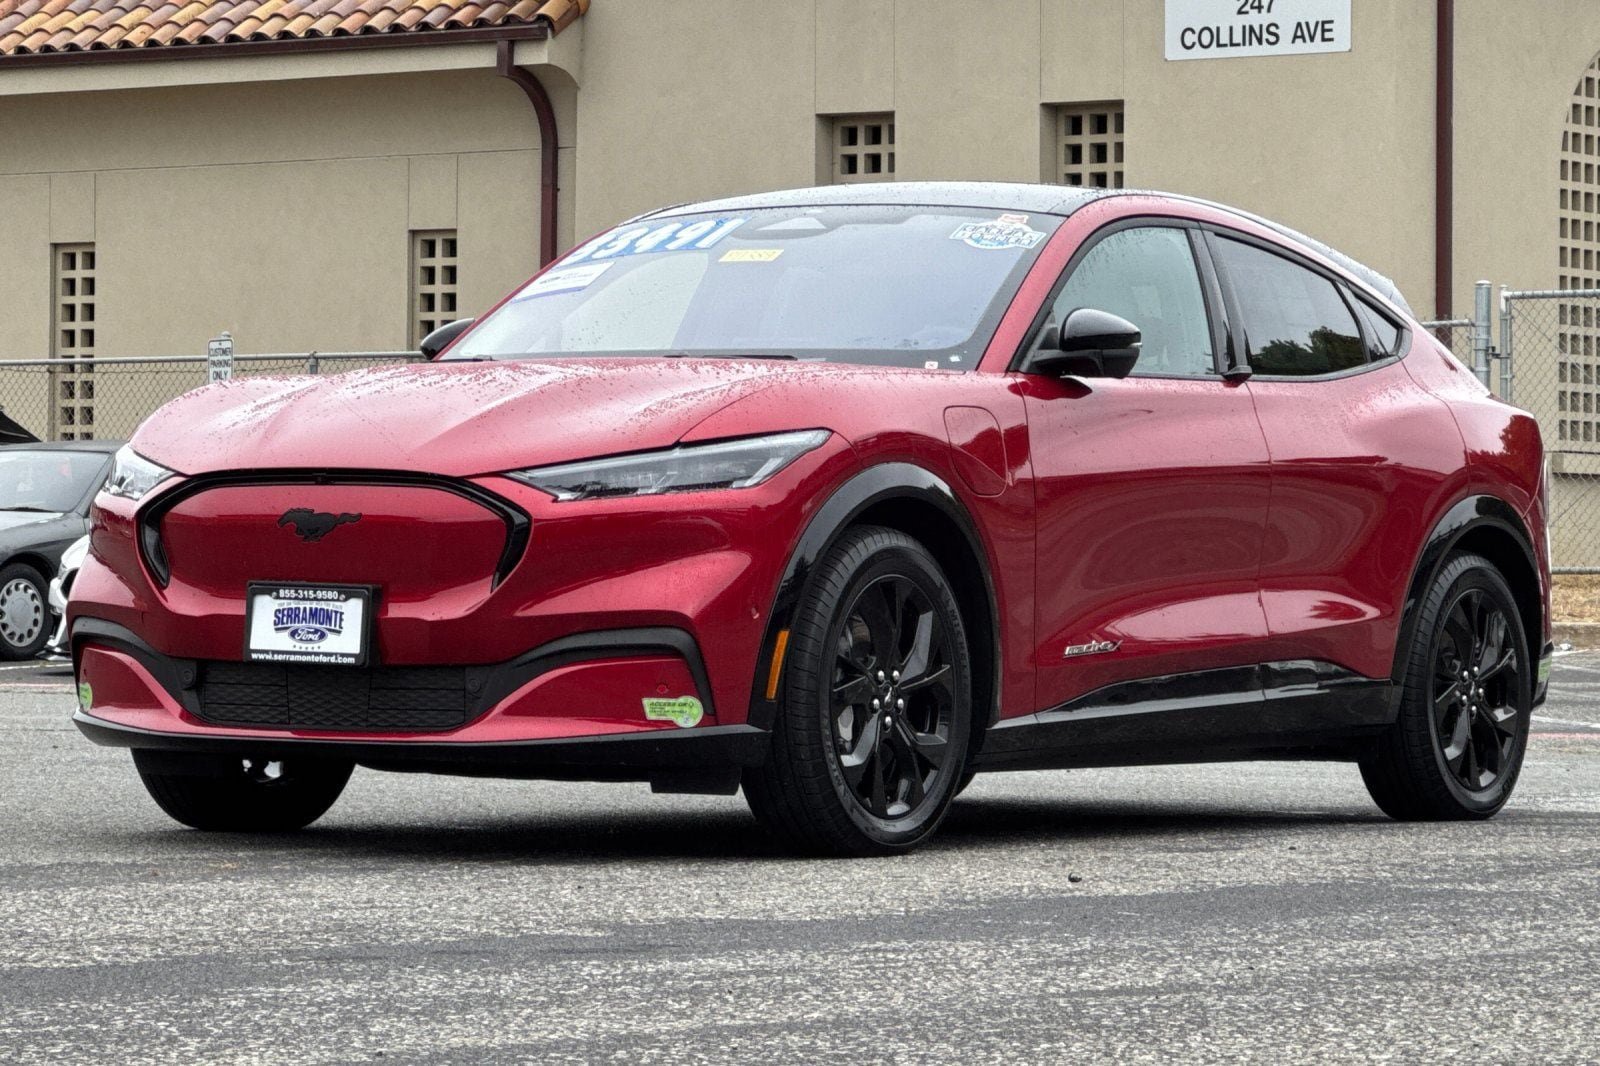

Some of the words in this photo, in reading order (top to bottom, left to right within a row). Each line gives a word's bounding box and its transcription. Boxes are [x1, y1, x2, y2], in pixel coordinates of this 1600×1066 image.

[1236, 0, 1275, 15] 247
[1180, 22, 1280, 51] COLLINS
[1290, 19, 1335, 45] AVE
[210, 359, 231, 368] PARKING
[212, 370, 229, 381] ONLY
[279, 589, 339, 600] 855-315-9580
[273, 606, 345, 630] SERRAMONTE
[294, 627, 321, 642] Ford
[251, 652, 356, 664] www.serramonteford.com
